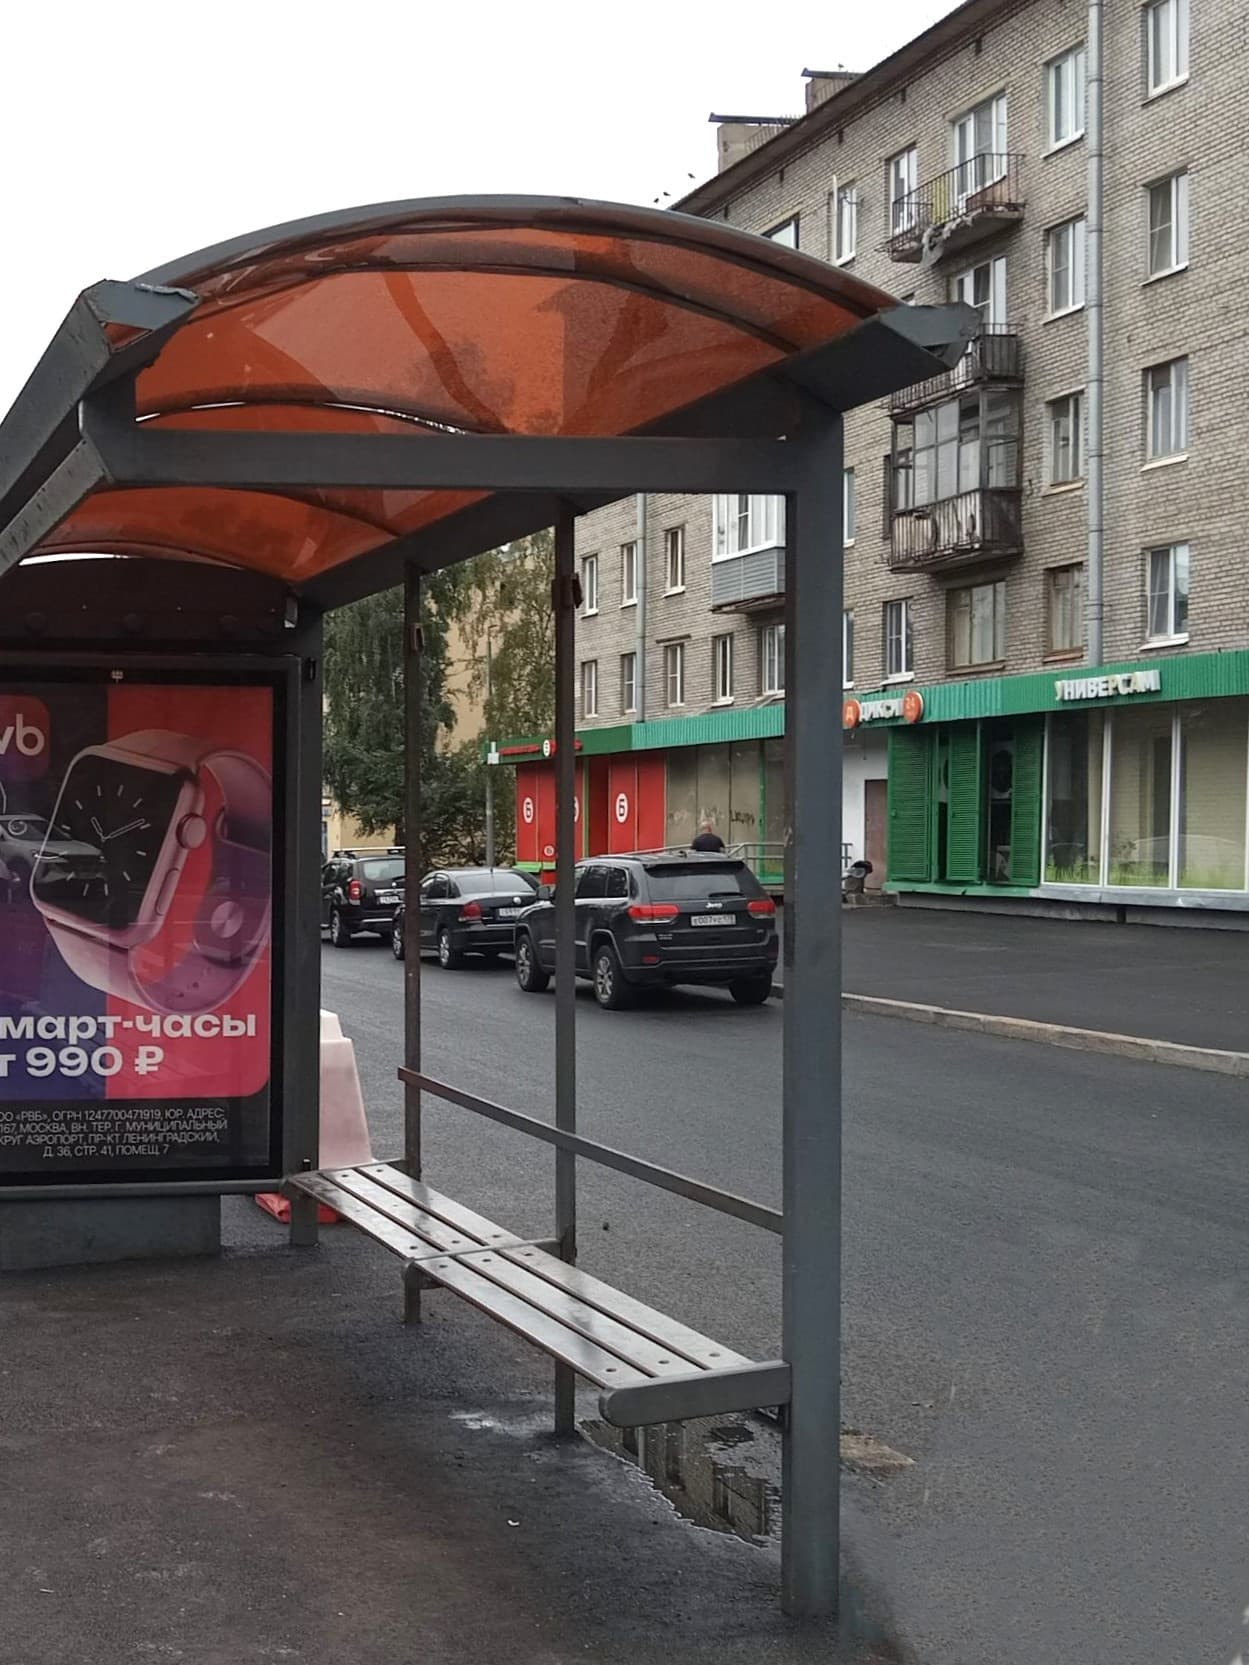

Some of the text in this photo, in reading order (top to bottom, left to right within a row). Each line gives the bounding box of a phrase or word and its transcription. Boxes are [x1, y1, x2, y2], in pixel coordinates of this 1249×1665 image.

[1054, 669, 1161, 700] УНИВЕРСАМ
[859, 698, 904, 722] ДИКСИ
[26, 1046, 123, 1077] 990
[134, 1046, 164, 1075] ₽
[52, 1110, 82, 1121] ОГРН
[165, 1108, 185, 1119] ЮР.
[19, 1122, 69, 1134] МОСКВА,
[88, 1133, 121, 1144] ПР-КТ
[74, 1145, 99, 1156] СТР.
